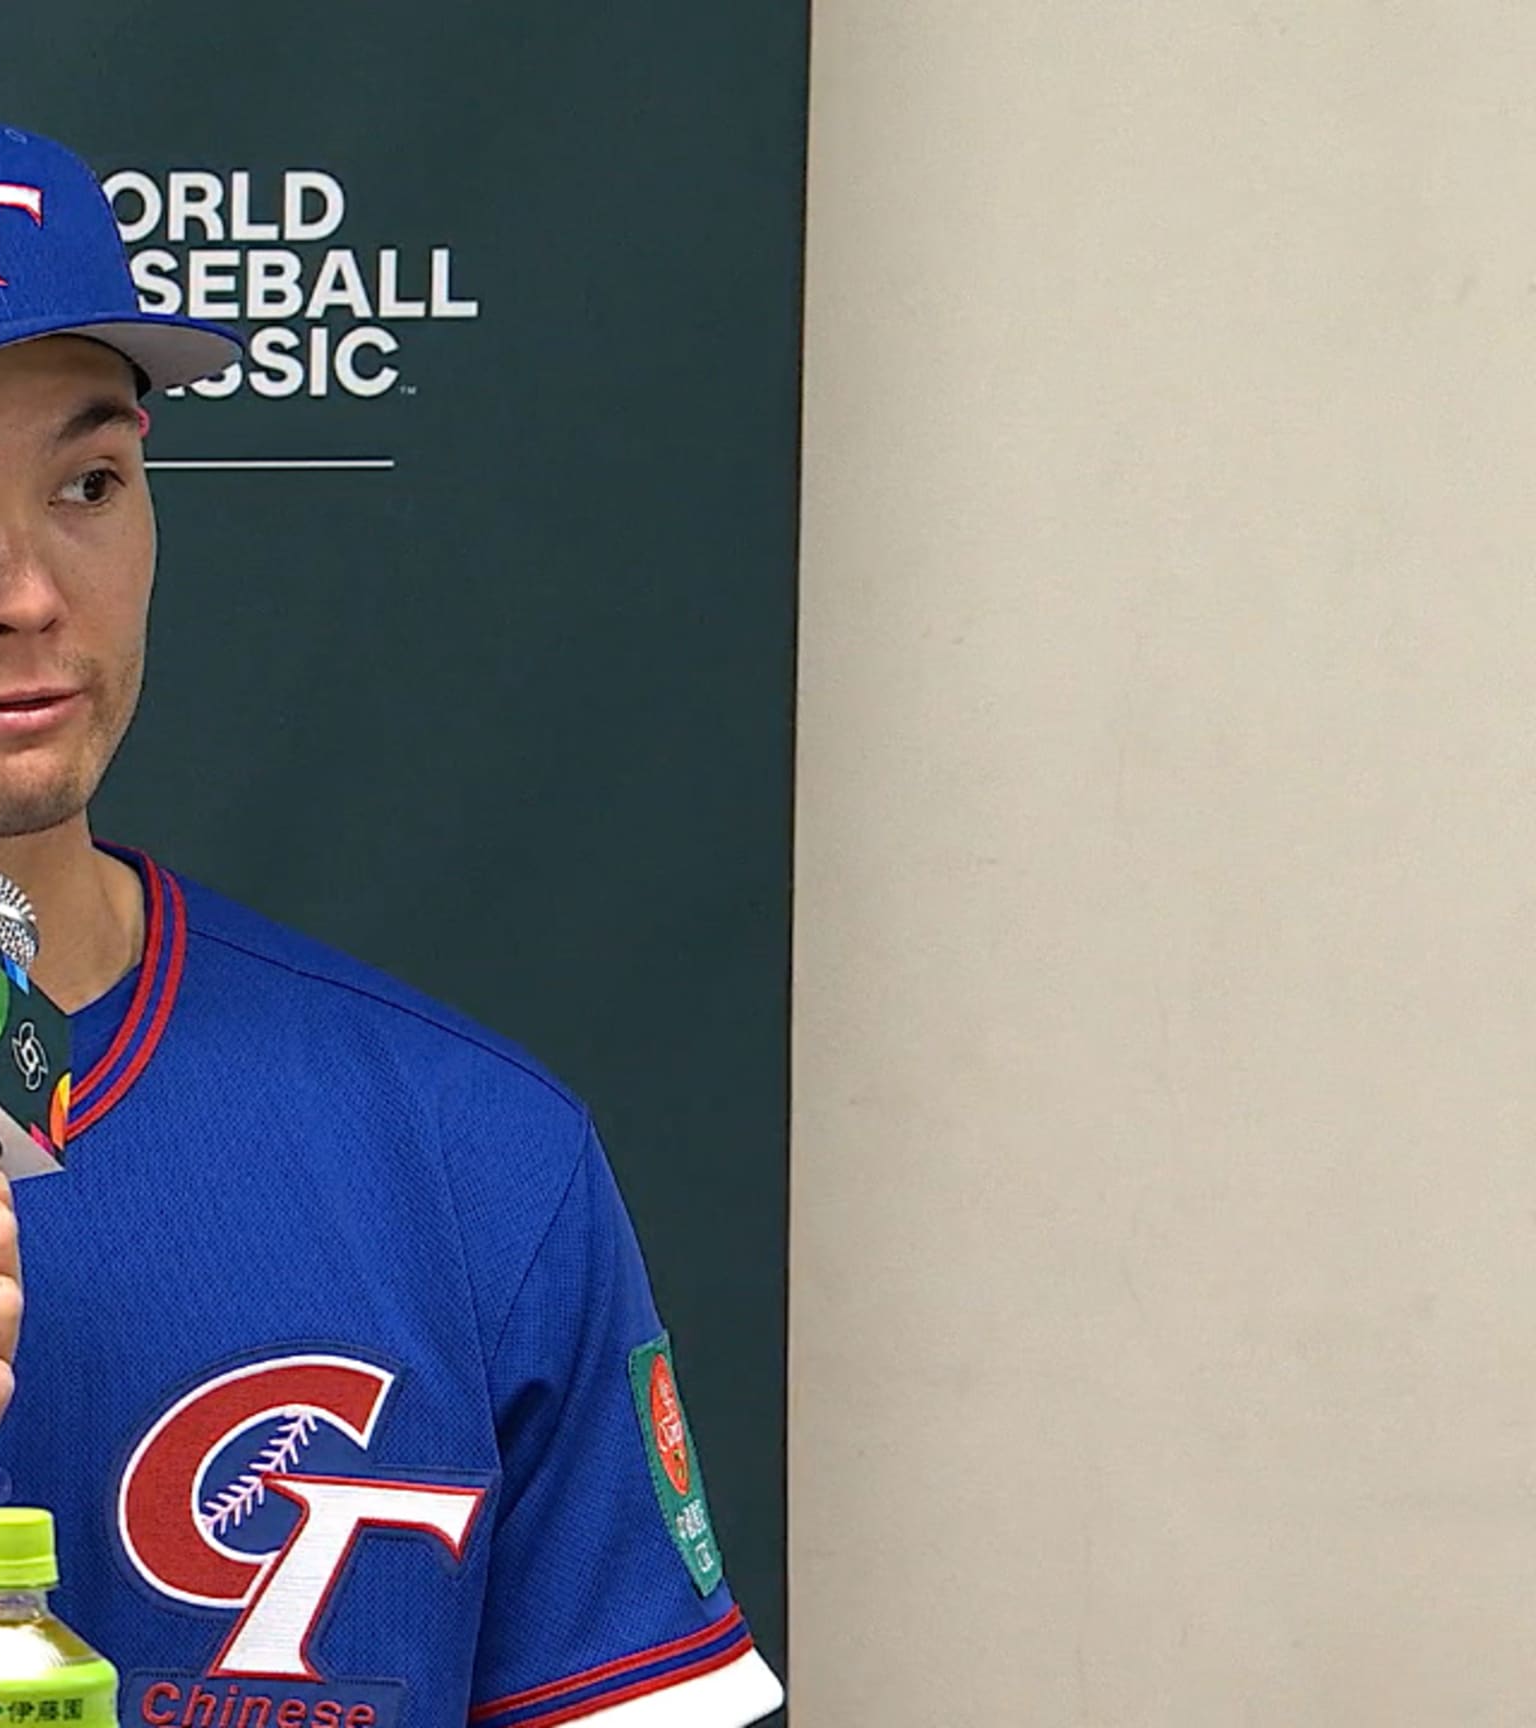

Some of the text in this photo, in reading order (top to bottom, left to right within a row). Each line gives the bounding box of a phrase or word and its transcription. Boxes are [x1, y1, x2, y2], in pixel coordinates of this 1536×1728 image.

[102, 171, 345, 241] ORLD
[129, 248, 479, 319] SEBALL
[117, 1353, 487, 1684] CT
[141, 1681, 376, 1728] Chinese
